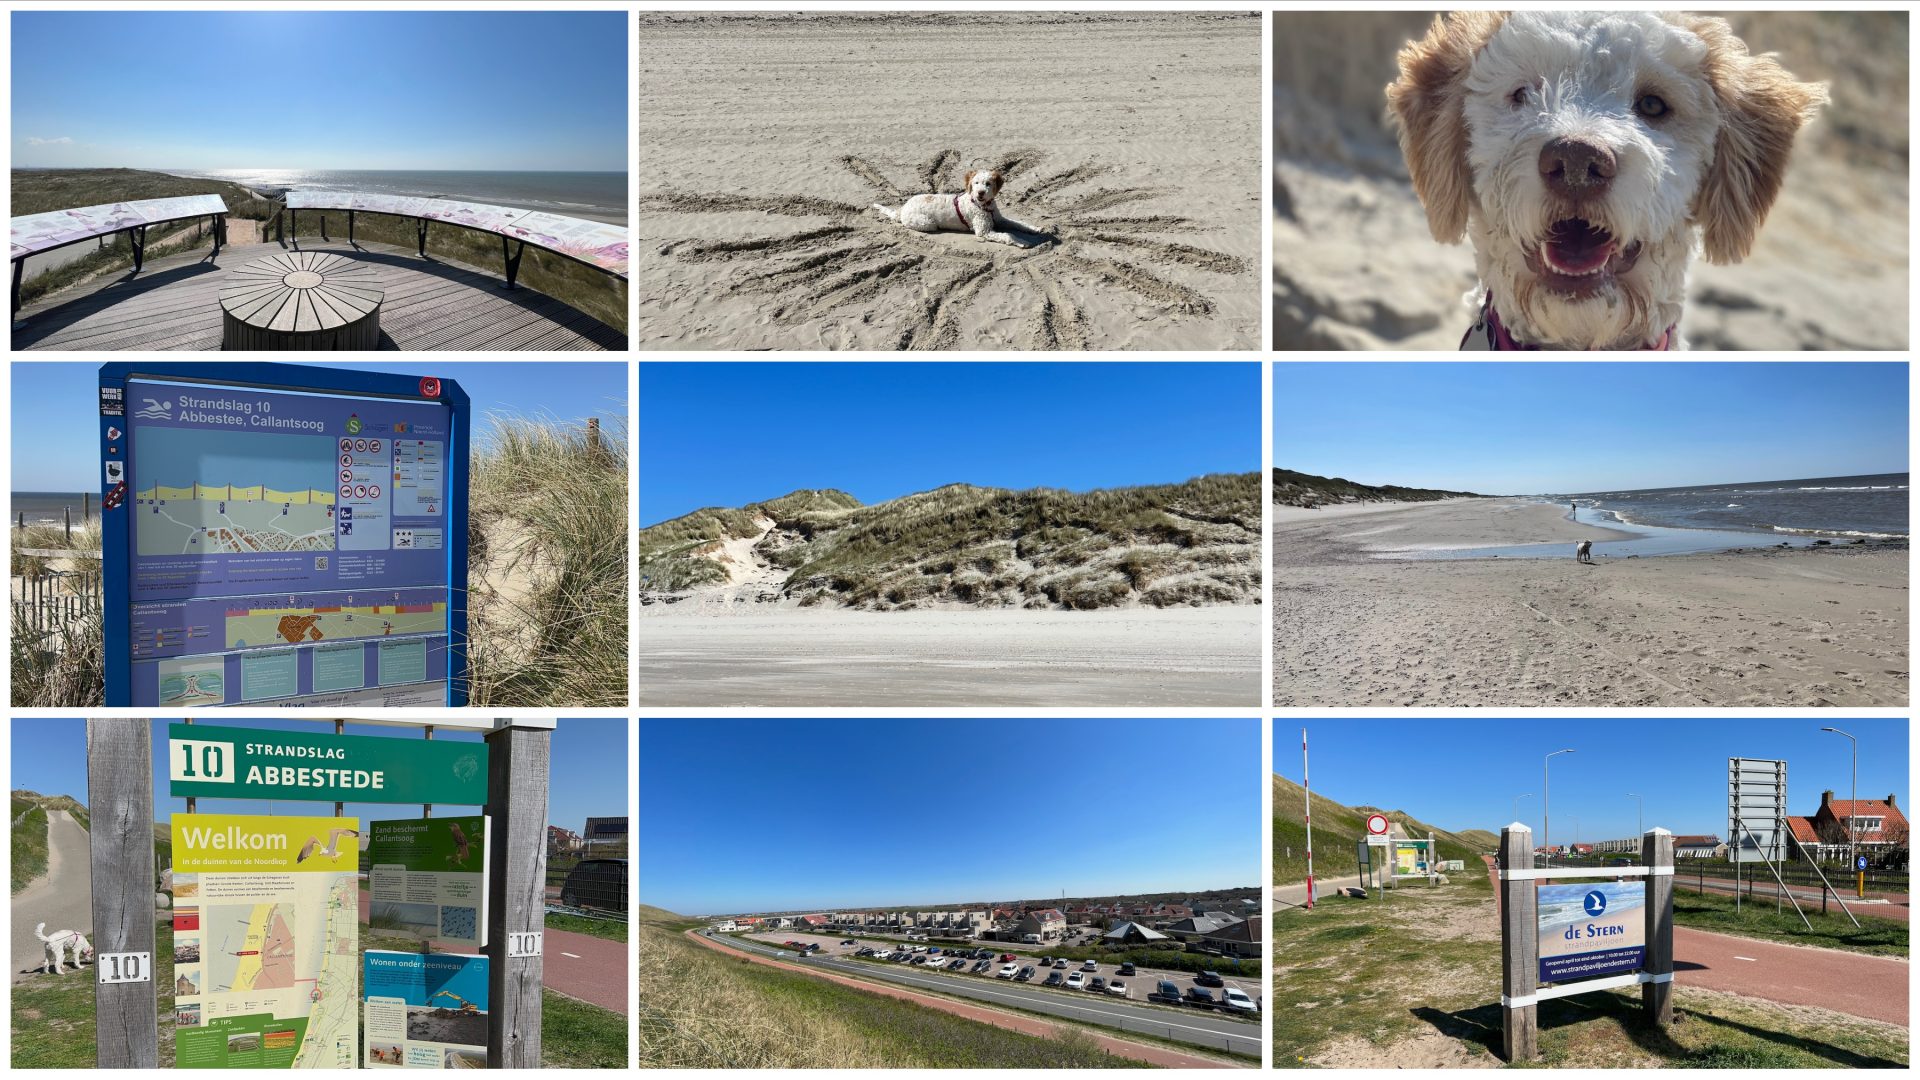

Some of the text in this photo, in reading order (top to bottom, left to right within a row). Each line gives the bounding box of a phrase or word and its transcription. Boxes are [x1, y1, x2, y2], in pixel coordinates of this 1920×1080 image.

[179, 396, 271, 413] Strandslag 10
[179, 410, 324, 432] Abbestee, Callantsoog
[245, 743, 345, 760] STRANDSLAG
[182, 744, 223, 778] 10
[245, 765, 384, 789] ABBESTEDE
[181, 826, 287, 850] Welkom
[375, 825, 428, 834] Zand beschermt
[375, 835, 415, 843] Callantsoog
[254, 858, 287, 866] Noordkop
[1587, 923, 1624, 938] STERN
[516, 935, 535, 954] 10
[110, 956, 139, 979] 10
[370, 958, 462, 970] Wonen onder zeeniveau
[1545, 959, 1565, 967] Geopend
[1550, 957, 1637, 975] www.strandpaviljoendestern.nl
